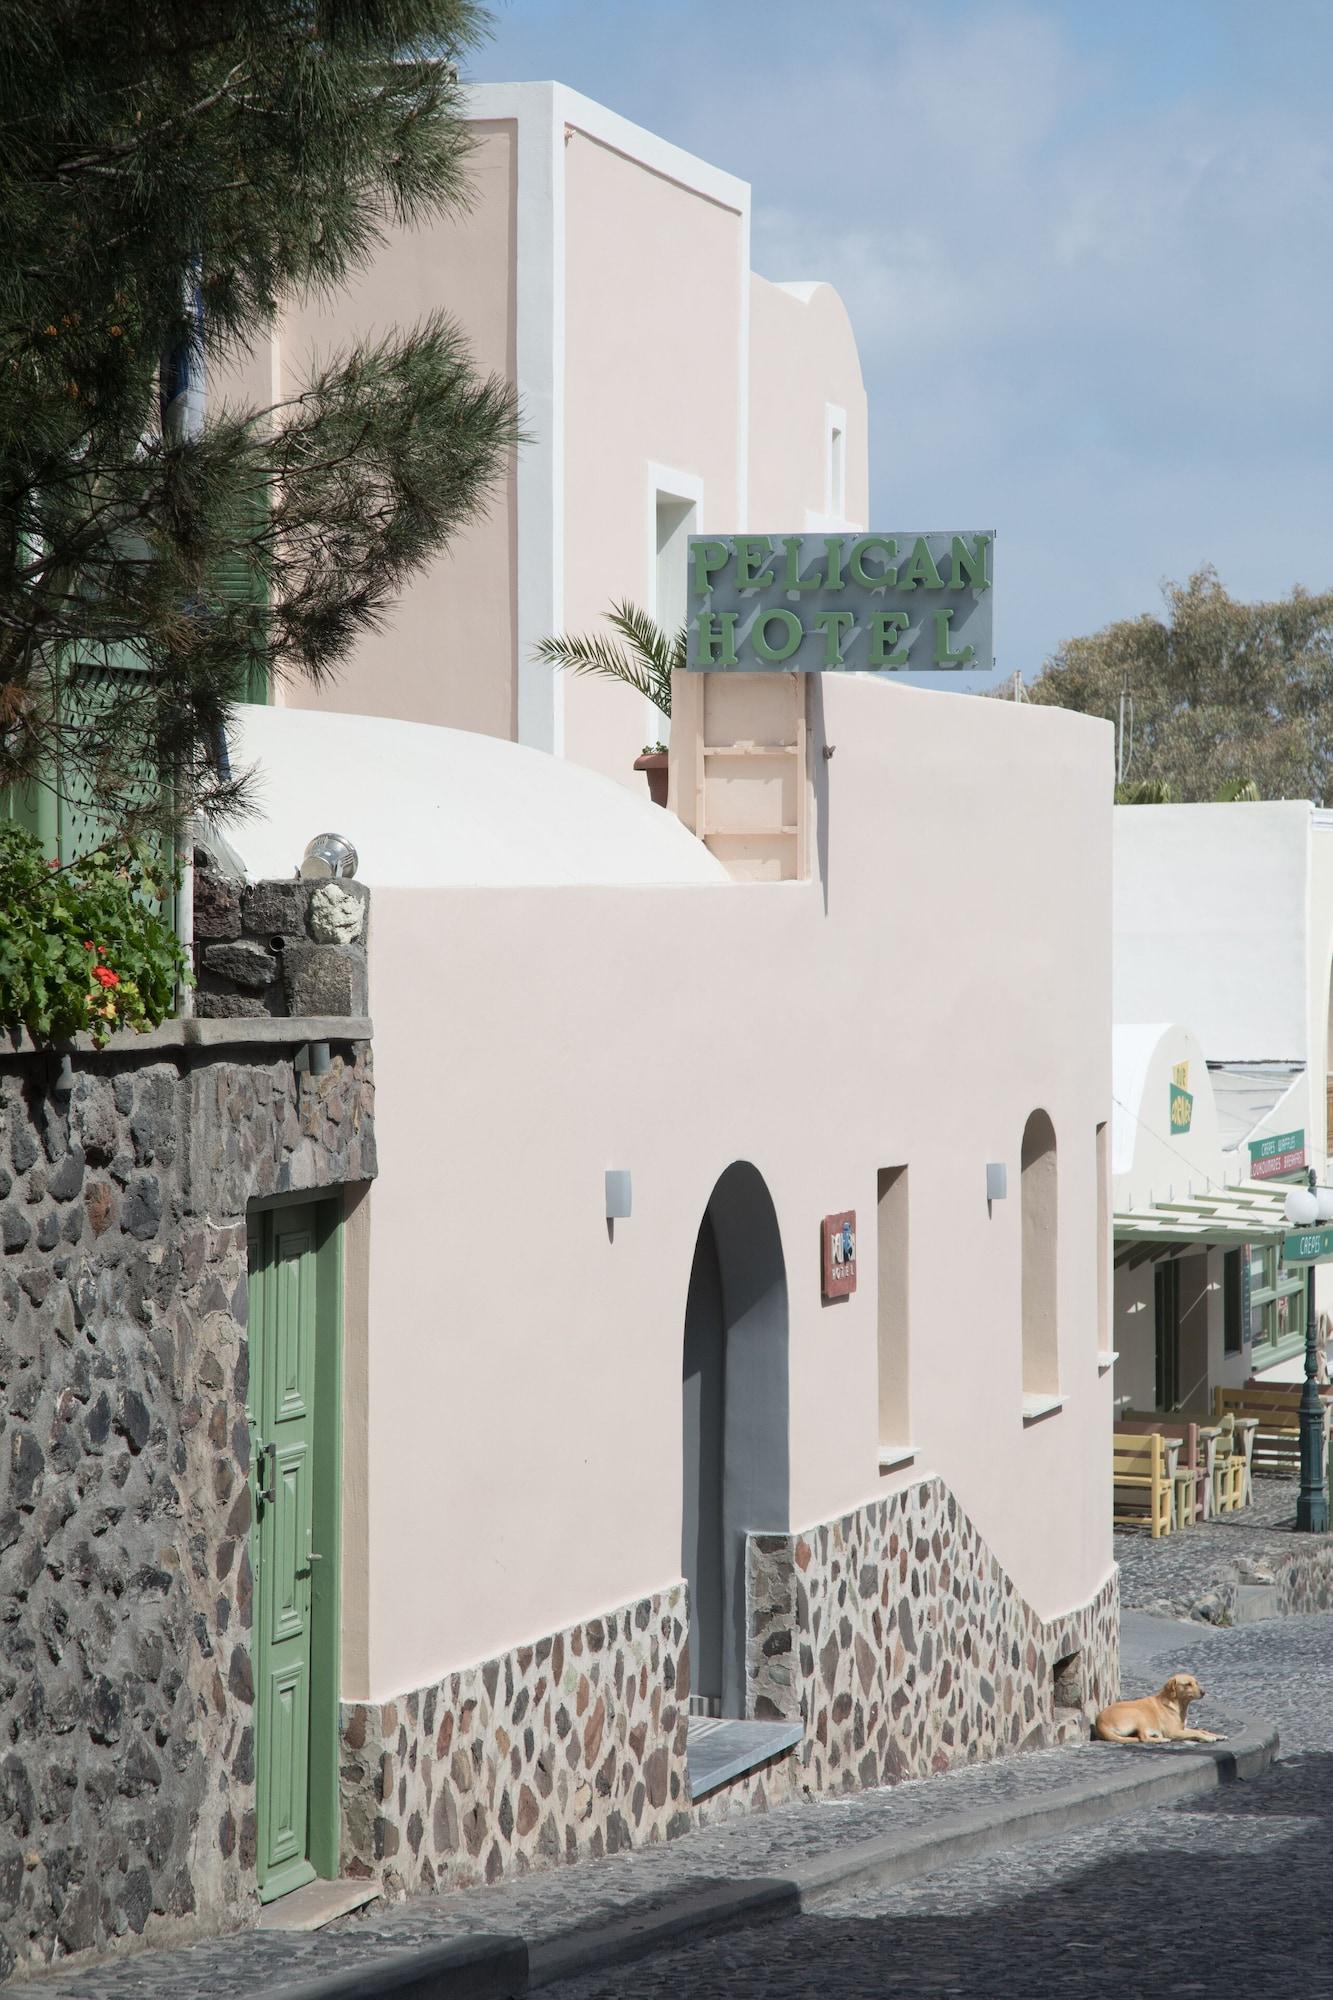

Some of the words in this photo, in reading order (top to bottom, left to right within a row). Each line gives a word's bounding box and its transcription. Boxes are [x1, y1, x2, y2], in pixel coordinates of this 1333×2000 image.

[690, 535, 992, 593] PELICAN
[696, 608, 974, 665] HOTEL
[1299, 1235, 1321, 1255] CREPES
